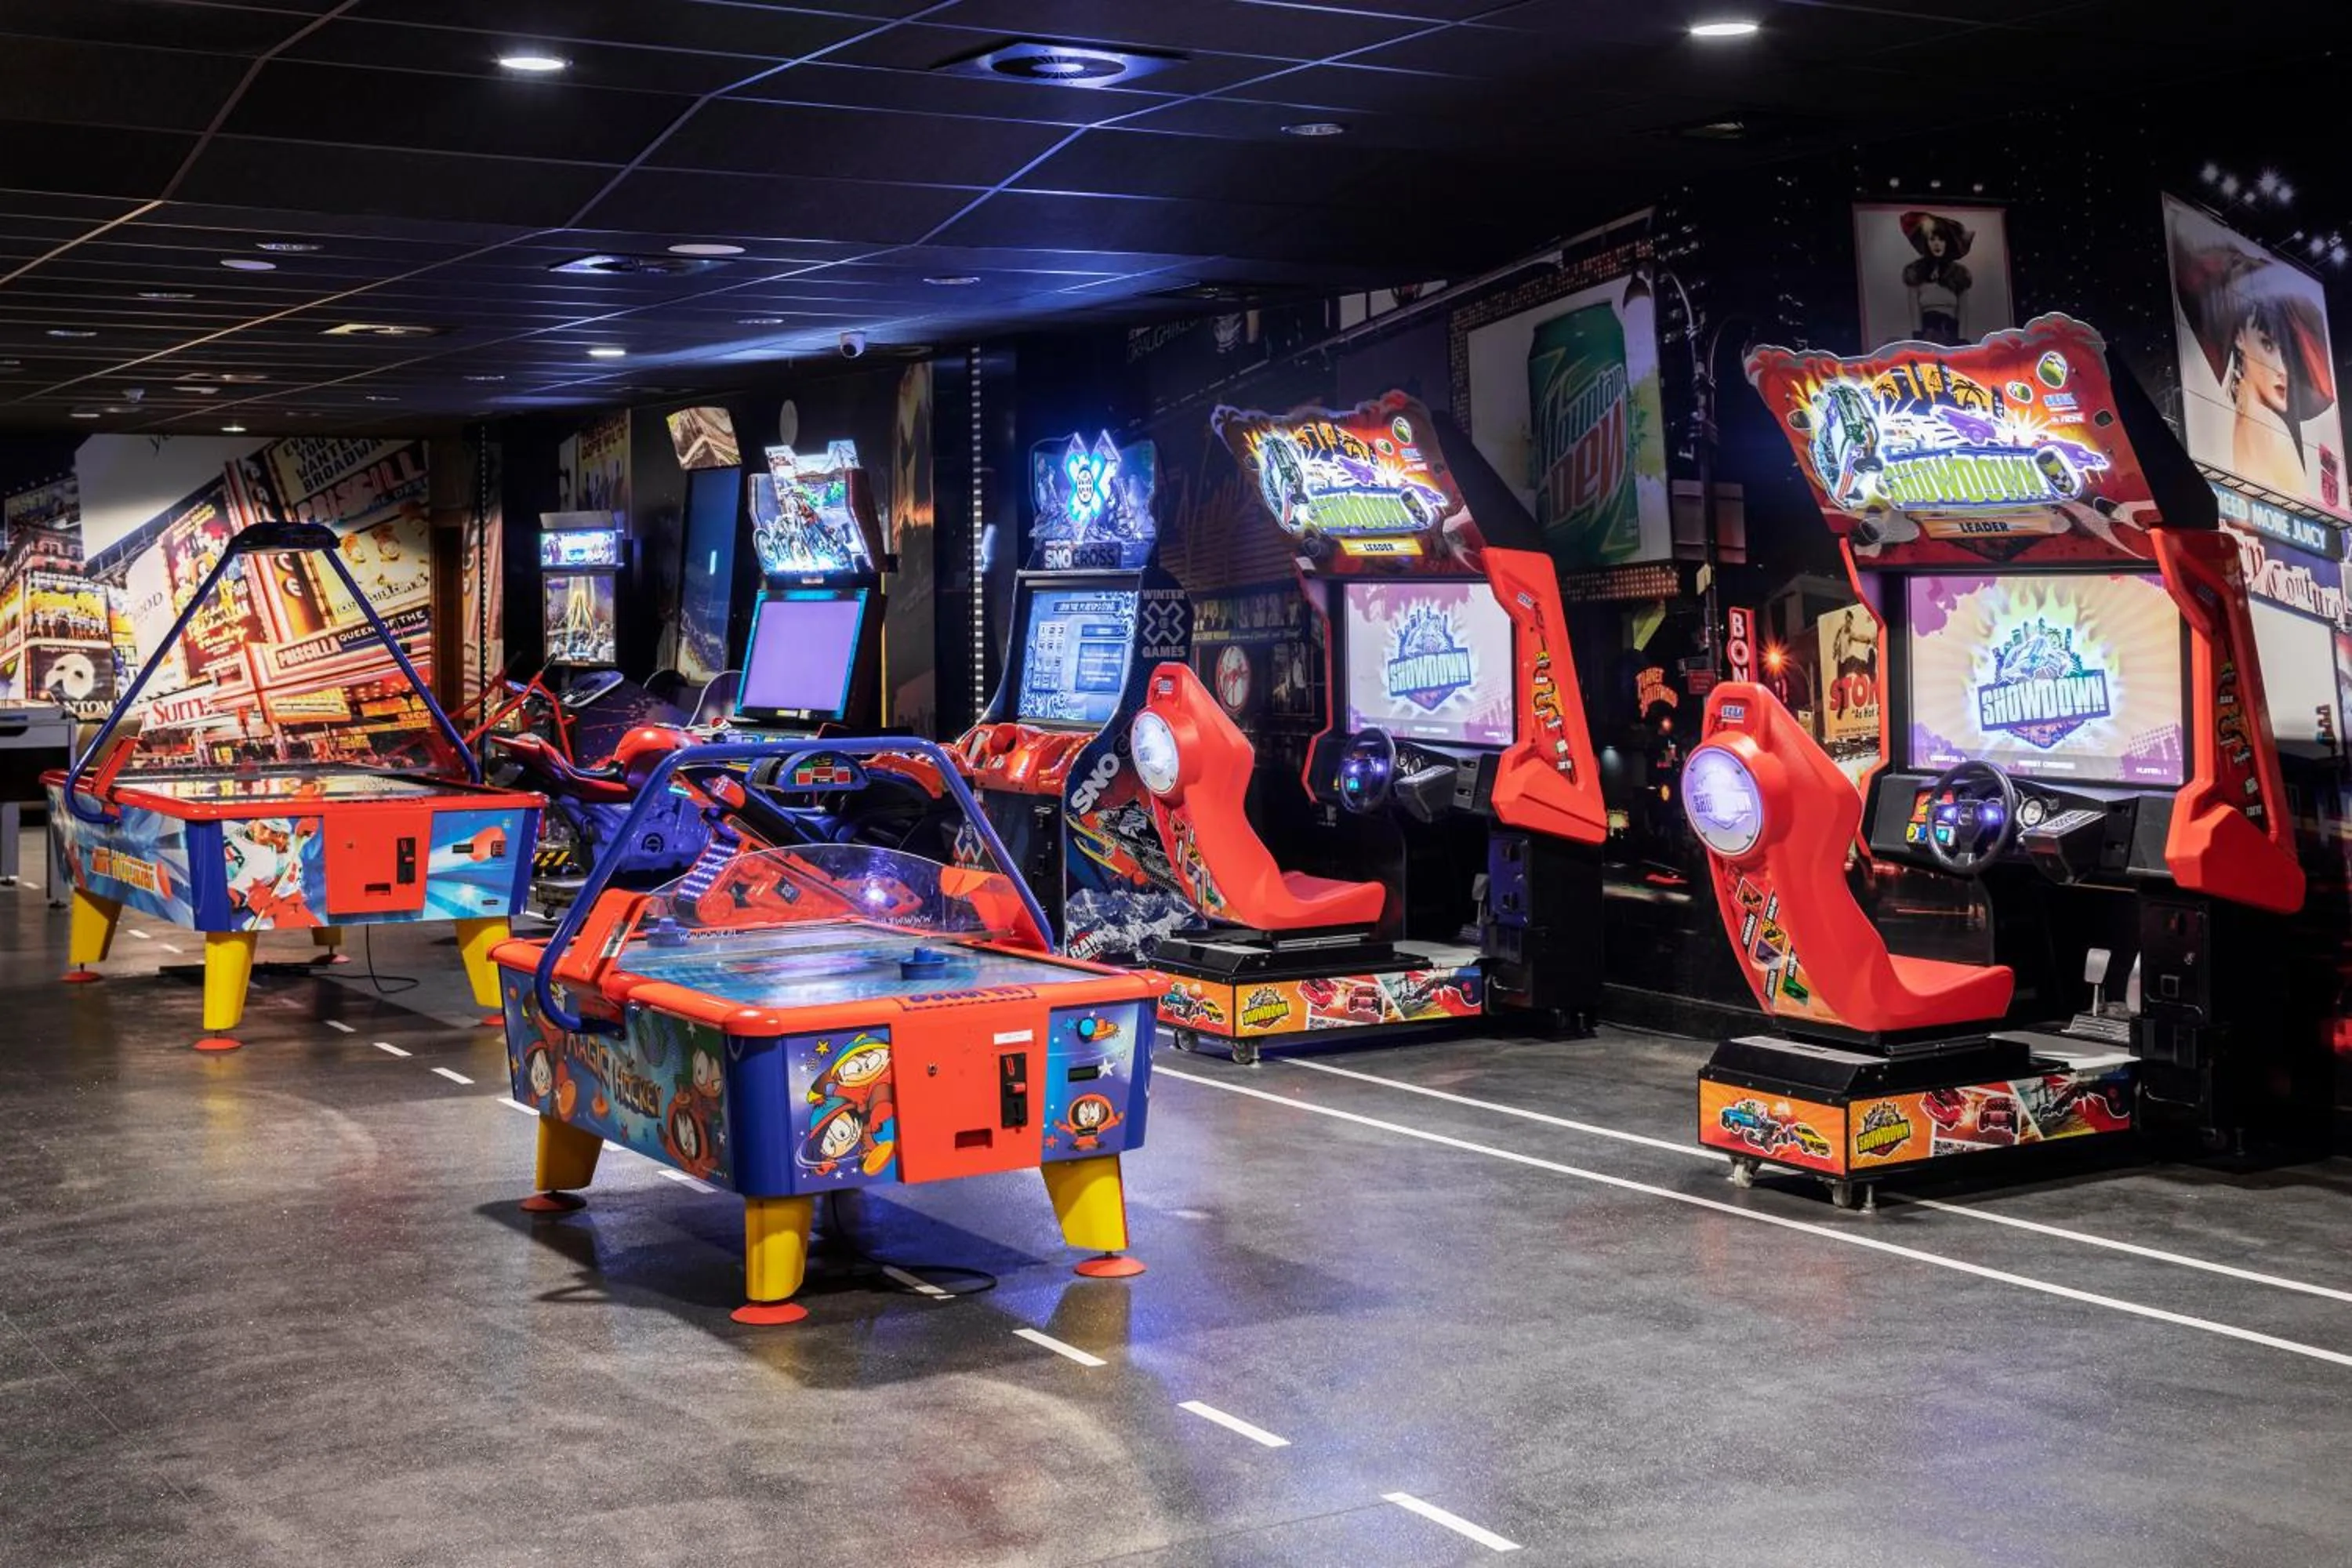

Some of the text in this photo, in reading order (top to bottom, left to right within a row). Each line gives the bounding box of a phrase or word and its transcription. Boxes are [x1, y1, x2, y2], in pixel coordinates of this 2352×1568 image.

[1959, 521, 2009, 534] LEADER
[2251, 503, 2290, 537] MORE
[2292, 519, 2327, 550] JUICY
[1363, 543, 1396, 552] LEADER
[1142, 590, 1185, 600] WINTER
[400, 609, 426, 625] THE
[1142, 645, 1186, 658] GAMES
[1388, 652, 1470, 695] SHOWDOWN
[1980, 679, 2107, 726] SHOWDOWN
[1070, 753, 1120, 815] SNO
[1858, 1121, 1910, 1152] SHOWDOWN
